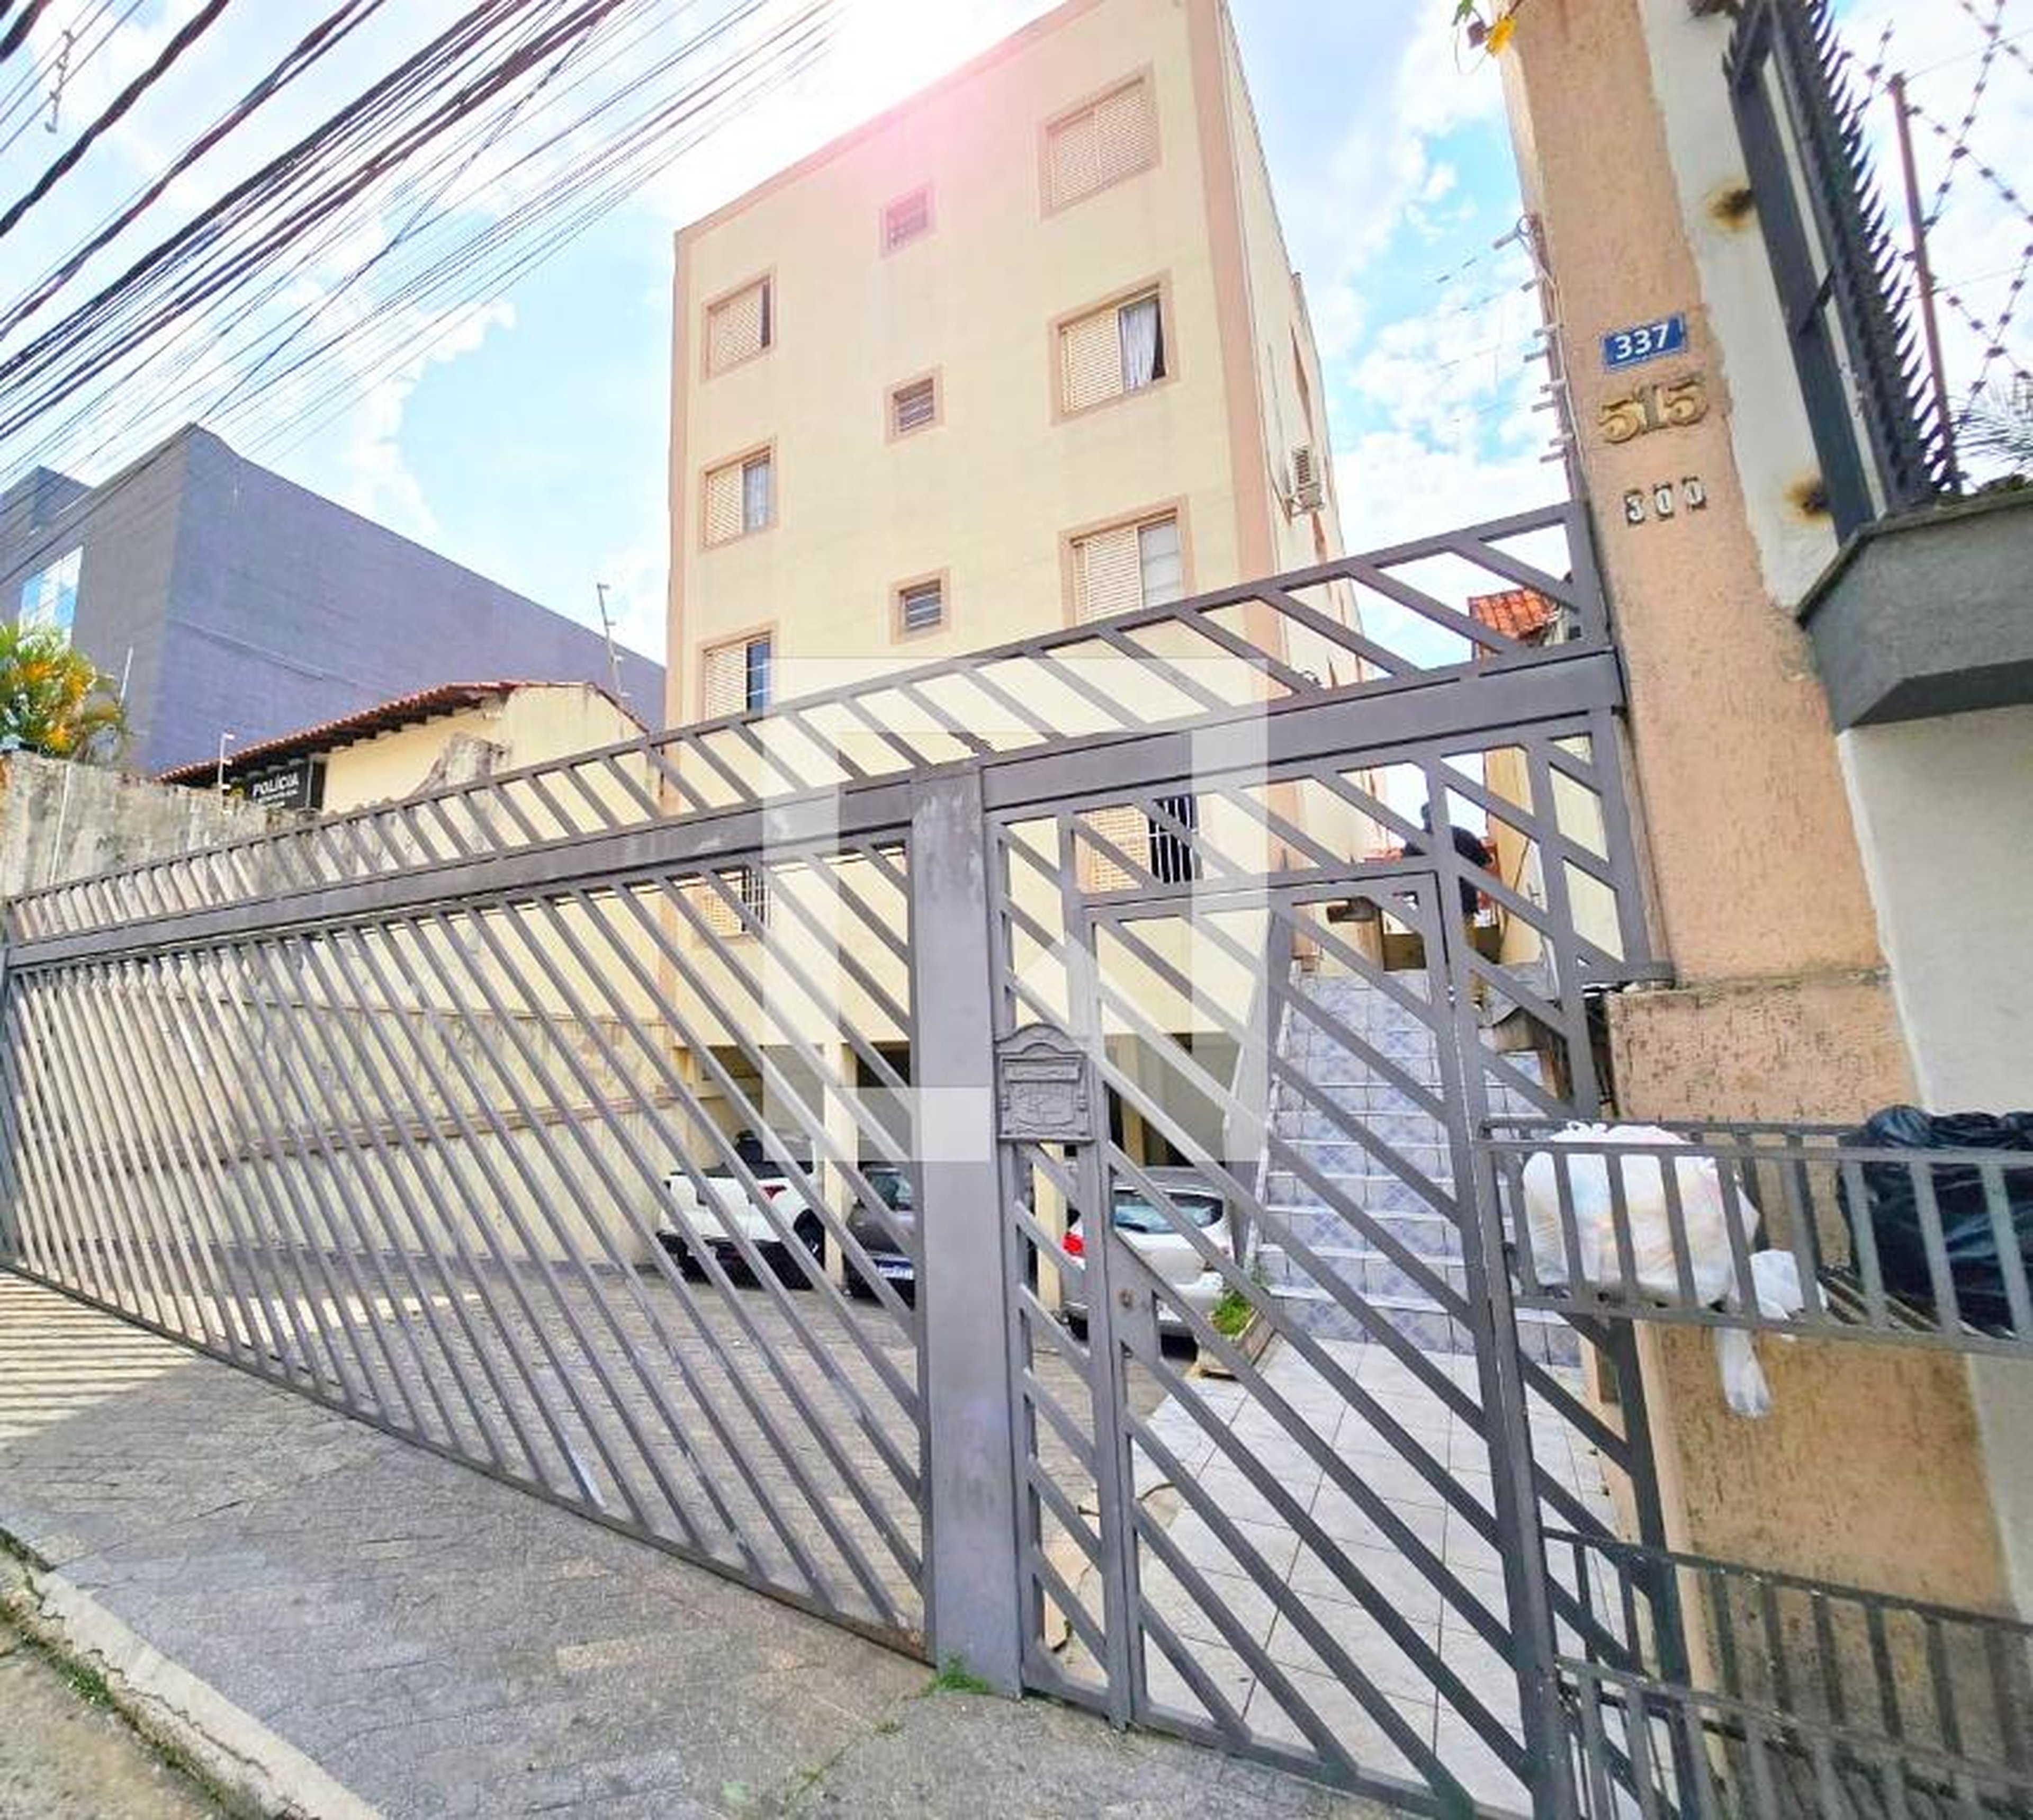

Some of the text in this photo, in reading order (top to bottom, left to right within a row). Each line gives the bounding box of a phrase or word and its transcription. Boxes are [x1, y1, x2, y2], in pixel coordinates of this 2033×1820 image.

[1613, 324, 1669, 361] 337
[1598, 371, 1710, 444] 515
[1624, 476, 1706, 525] 300
